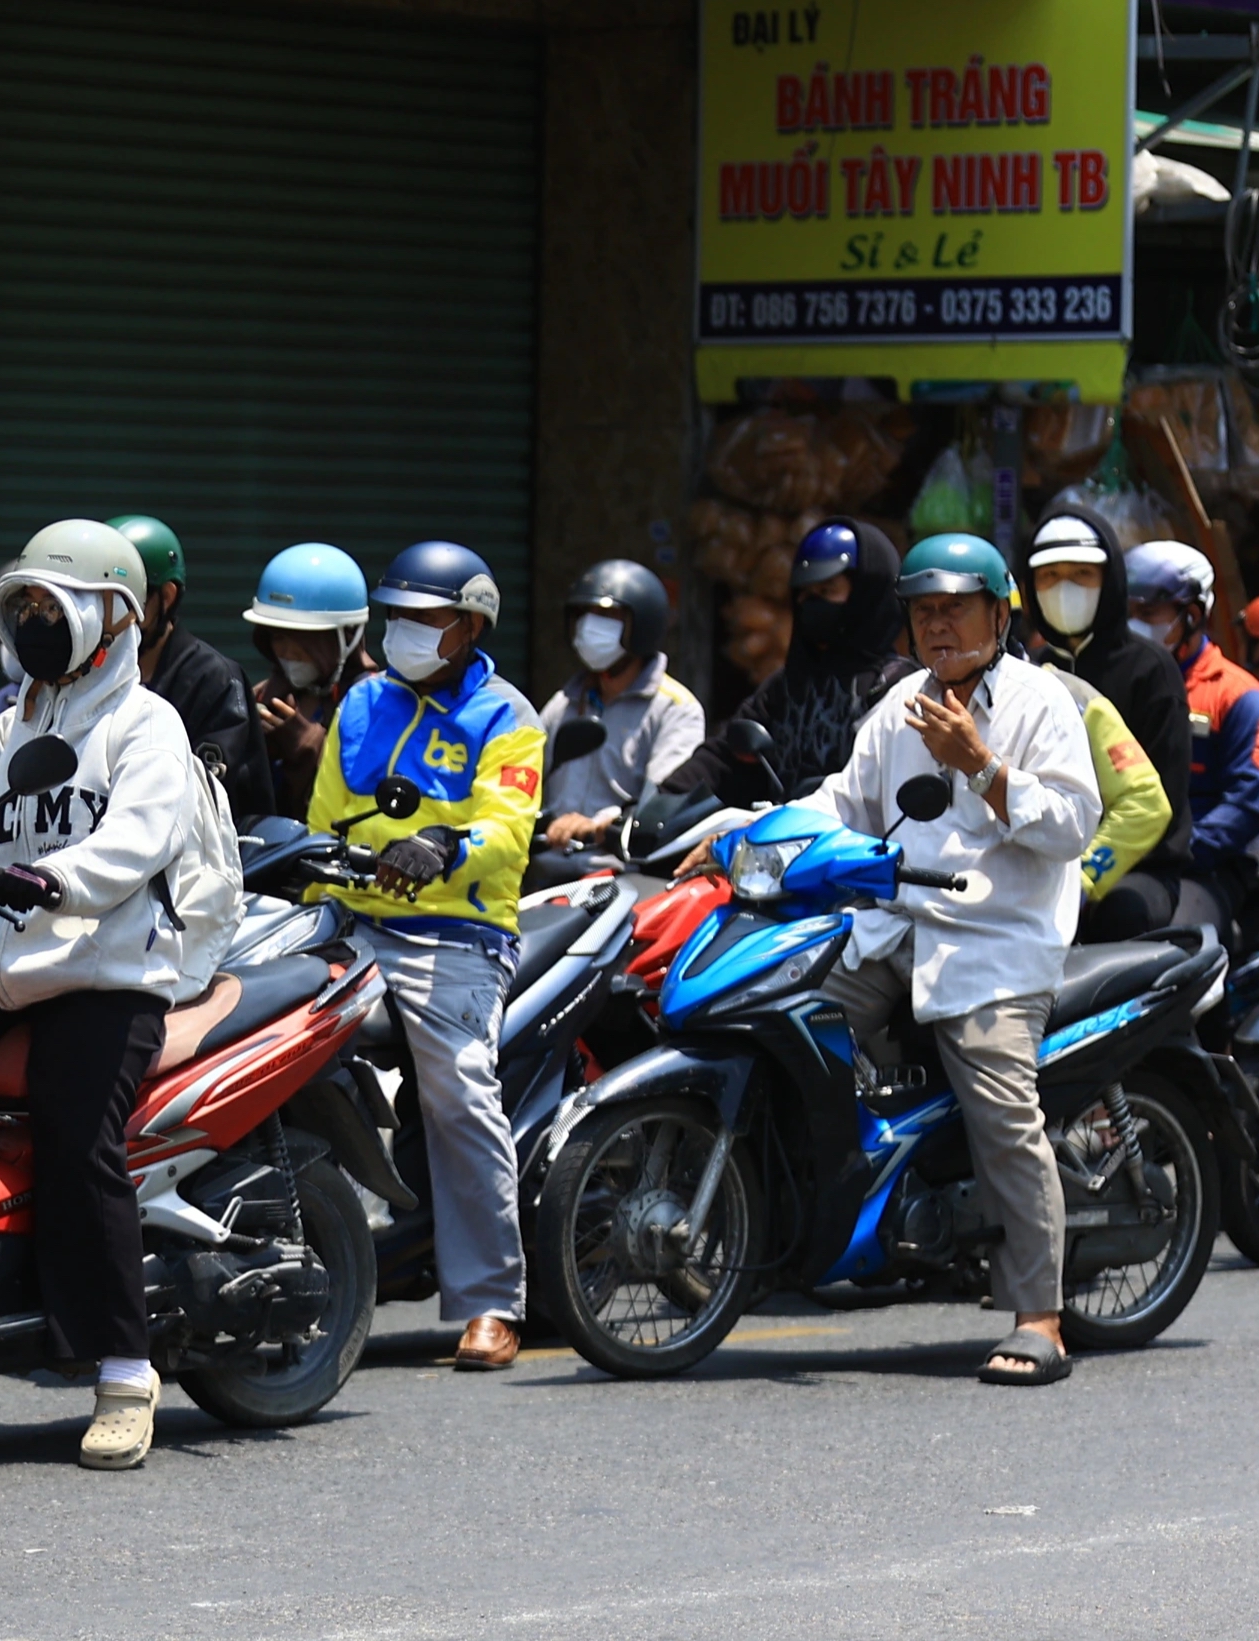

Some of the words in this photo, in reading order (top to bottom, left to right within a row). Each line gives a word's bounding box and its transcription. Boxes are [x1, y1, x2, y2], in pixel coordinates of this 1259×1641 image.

[732, 10, 779, 52] ĐẠI
[788, 1, 821, 43] LÝ
[841, 146, 919, 216] TÂY
[933, 152, 1041, 214] NINH
[1054, 149, 1109, 211] TB
[893, 241, 919, 270] &
[709, 293, 746, 328] ĐT:
[855, 289, 917, 325] 7376
[939, 287, 1004, 324] 0375
[1009, 286, 1057, 324] 333
[1063, 284, 1113, 323] 236
[423, 728, 468, 773] be
[810, 1012, 843, 1021] HONDA
[1, 1192, 33, 1212] HON
